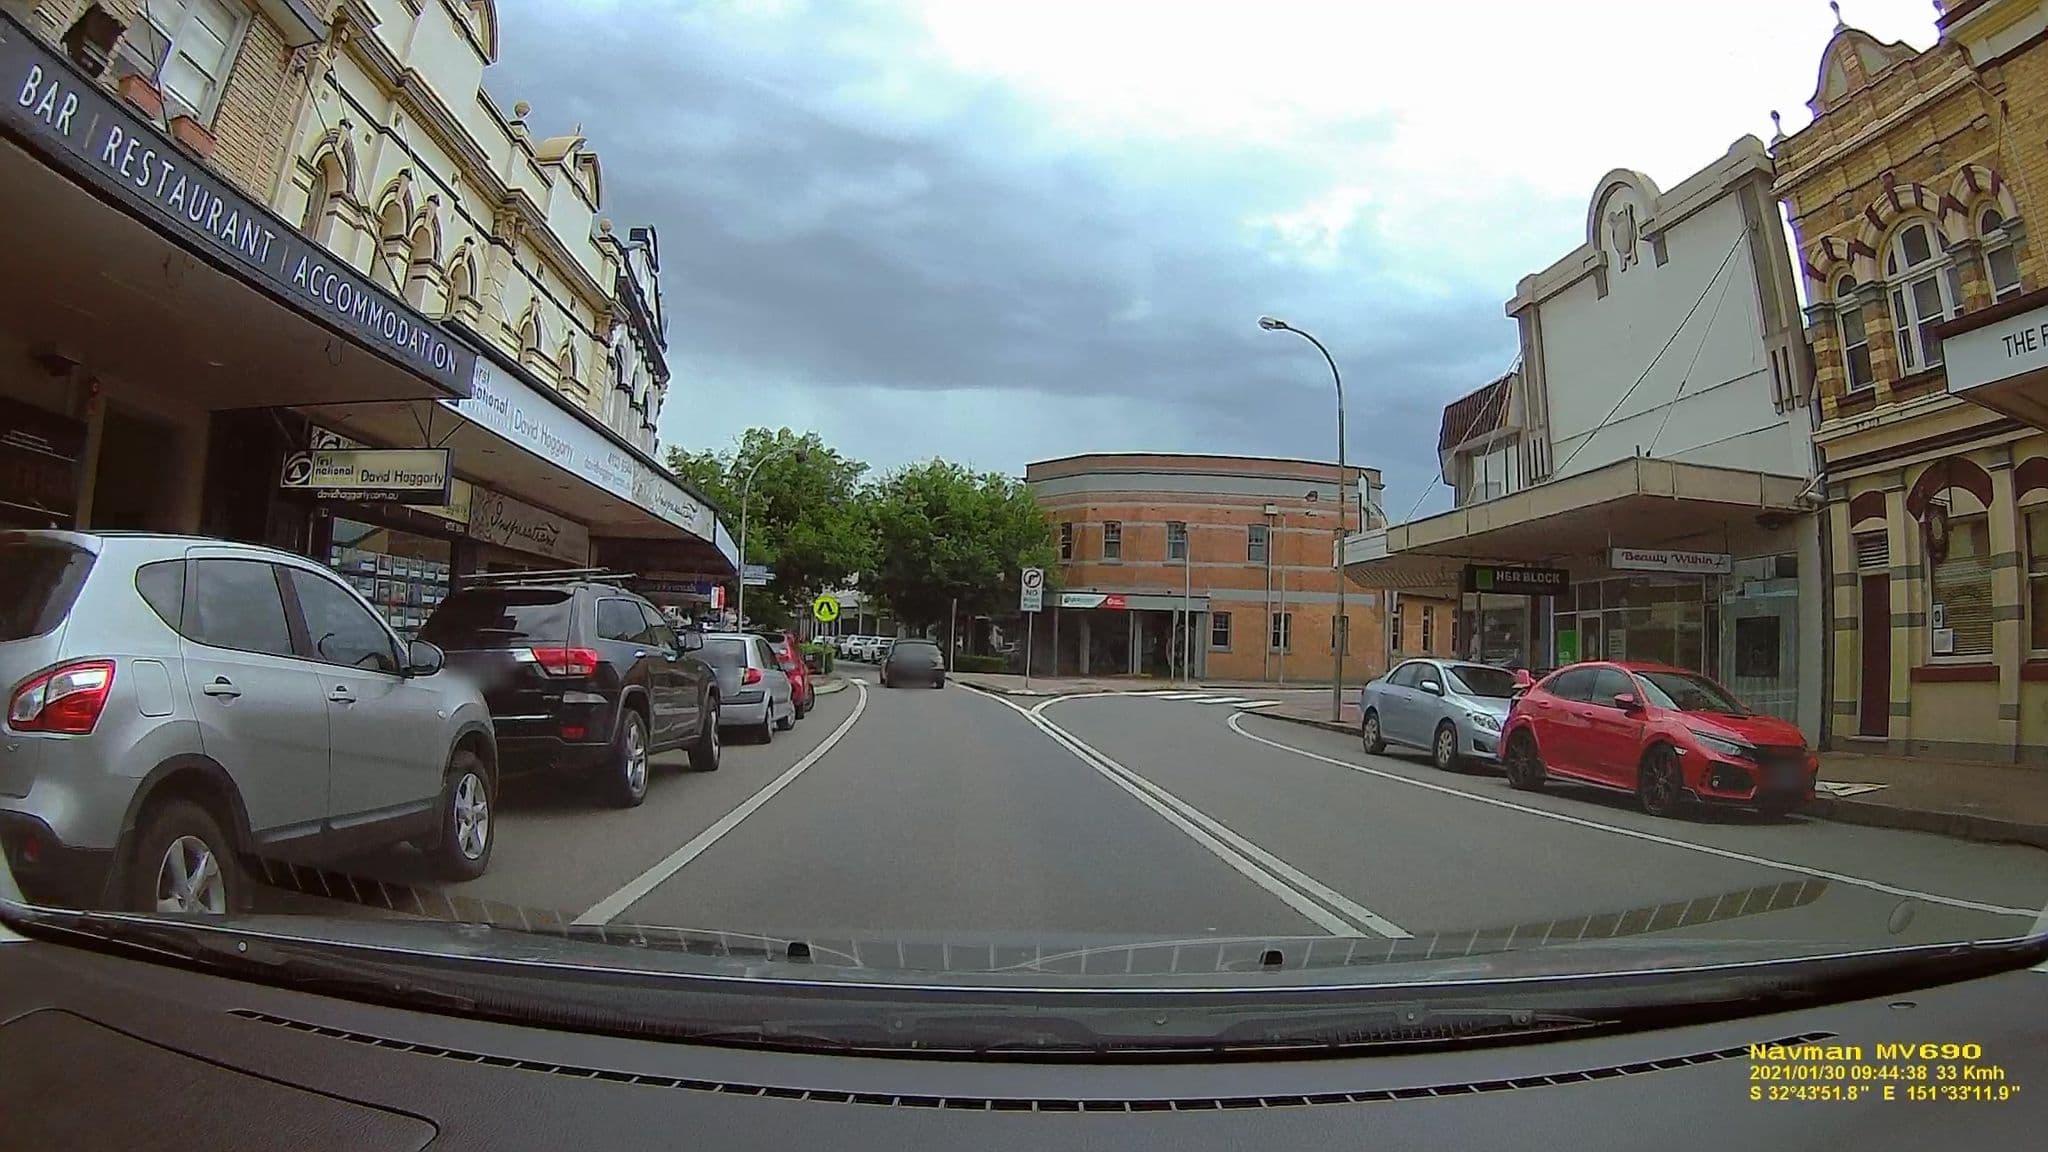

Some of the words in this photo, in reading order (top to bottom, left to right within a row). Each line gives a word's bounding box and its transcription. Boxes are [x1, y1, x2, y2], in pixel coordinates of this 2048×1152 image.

[19, 63, 79, 138] BAR
[101, 125, 277, 265] RESTAURANT
[292, 255, 458, 375] ACCOMMODATION
[2002, 327, 2037, 358] THE
[513, 408, 539, 440] David
[315, 464, 354, 476] national
[360, 469, 391, 484] David
[394, 470, 445, 487] Haggarty
[1621, 551, 1668, 565] Beauty
[1671, 553, 1714, 565] Within
[1495, 569, 1521, 582] HER
[1522, 570, 1561, 585] BLOCK
[1025, 588, 1039, 597] NO
